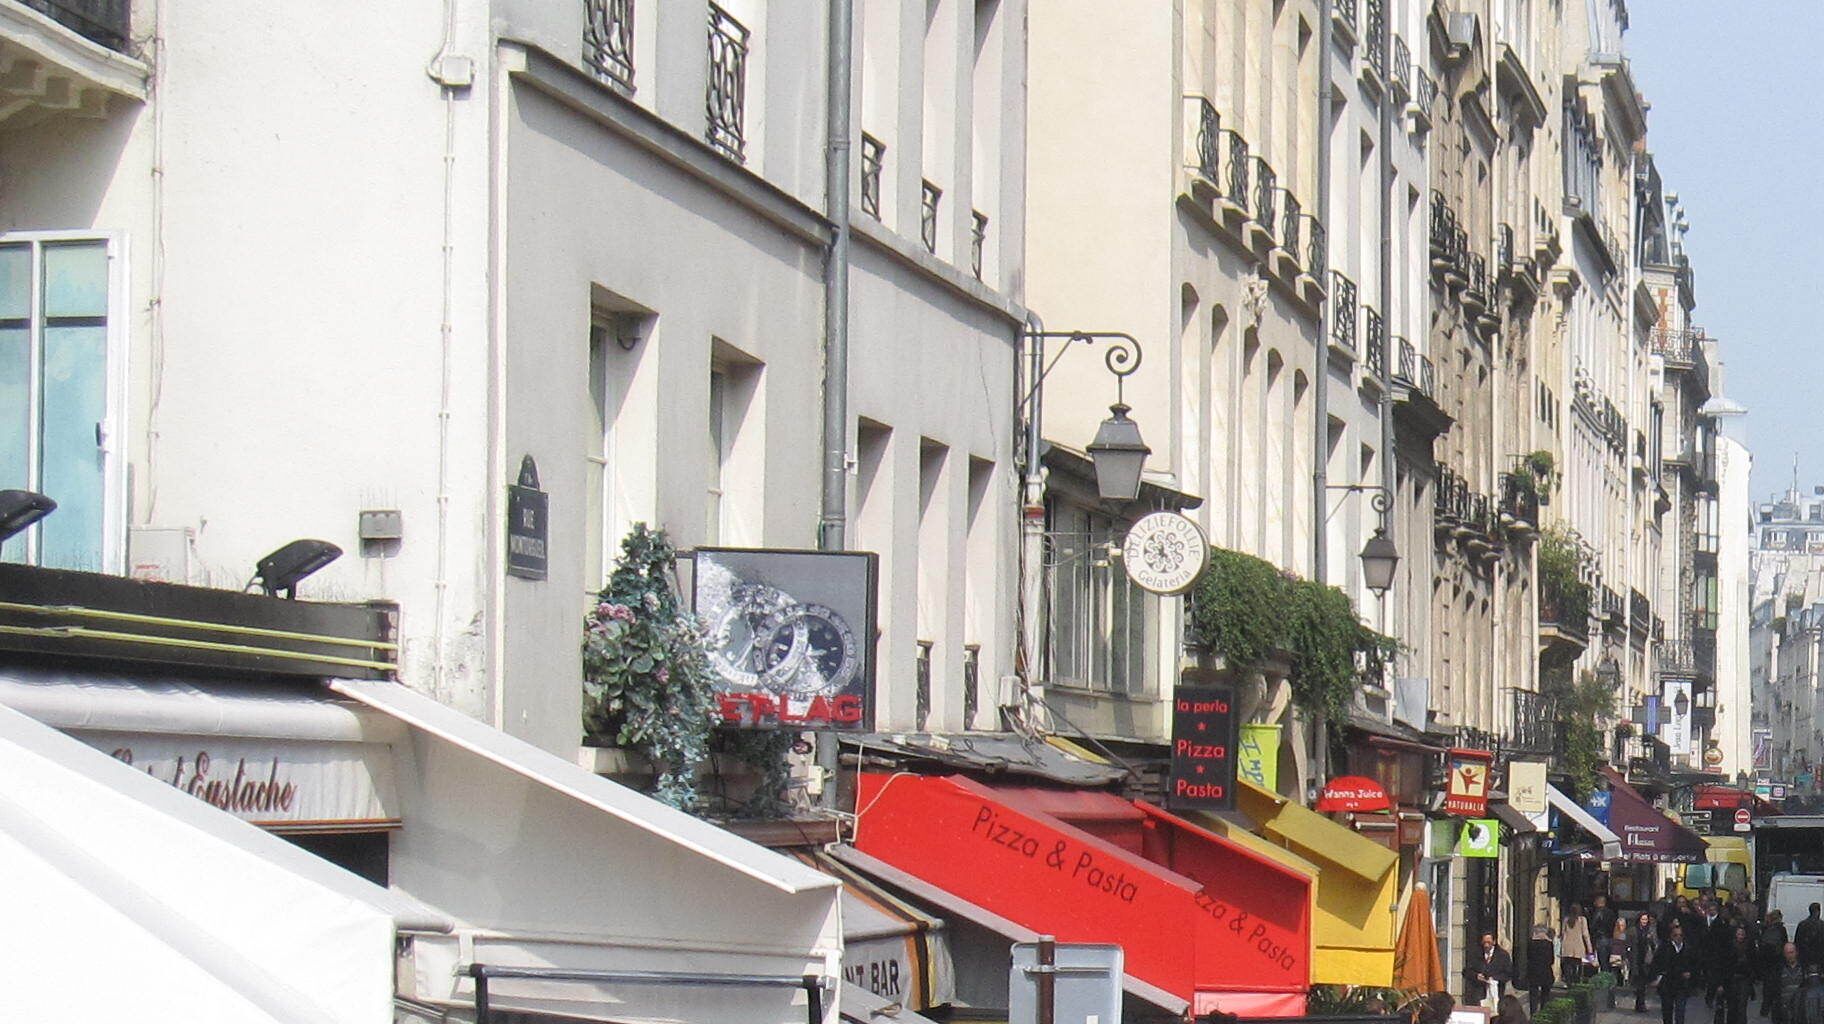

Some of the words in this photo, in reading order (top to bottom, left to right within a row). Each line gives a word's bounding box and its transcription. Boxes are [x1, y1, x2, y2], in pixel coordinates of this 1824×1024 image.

[522, 507, 536, 530] RUE
[1137, 569, 1193, 589] Gelateria
[714, 692, 864, 725] ET-LAG
[1176, 698, 1189, 712] la
[1194, 699, 1228, 715] perla
[1176, 738, 1226, 759] Pizza
[187, 751, 299, 813] Eustache
[1176, 778, 1223, 799] Pasta
[971, 804, 1040, 860] Pizza
[1045, 839, 1067, 871] &
[1071, 850, 1138, 904] Pasta
[1228, 910, 1249, 936] &
[1248, 922, 1297, 973] Pasta
[870, 959, 900, 996] BAR
